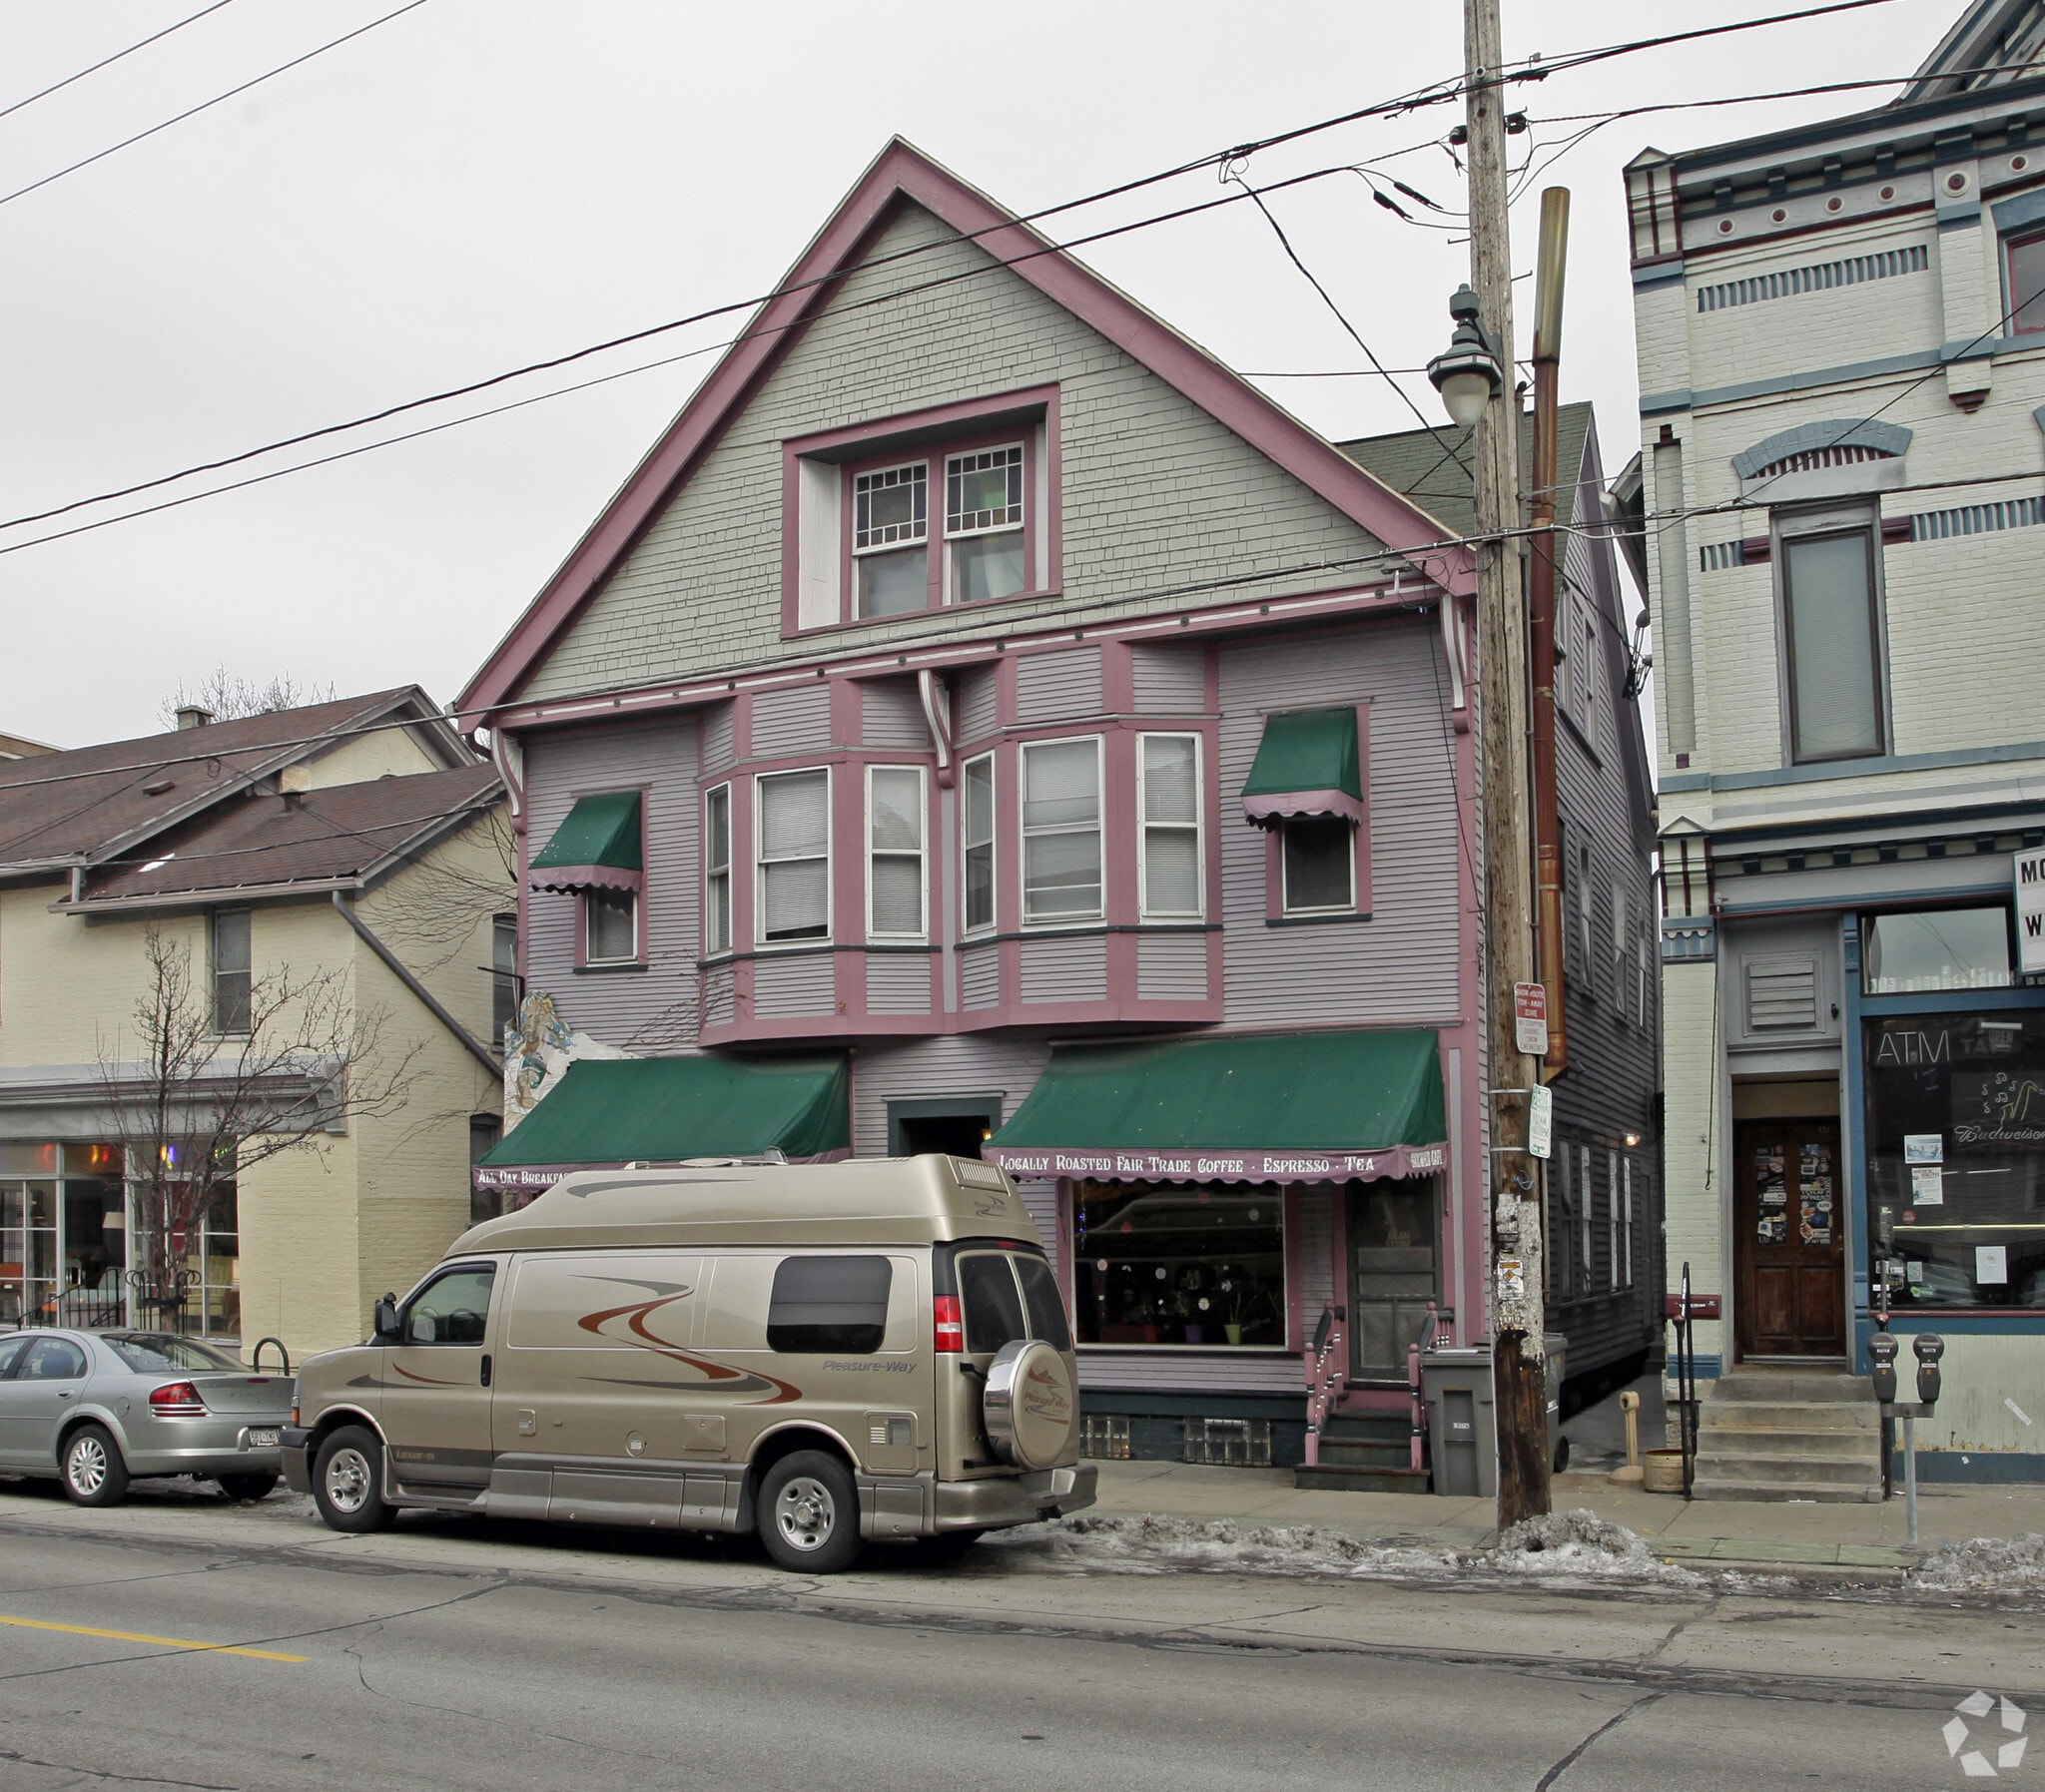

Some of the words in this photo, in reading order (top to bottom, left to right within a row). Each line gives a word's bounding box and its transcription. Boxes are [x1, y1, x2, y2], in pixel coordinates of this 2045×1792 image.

[1988, 1030, 2013, 1044] OPEN
[1876, 1029, 1950, 1065] ATM
[999, 1154, 1049, 1171] LOCALLY
[1055, 1155, 1111, 1172] ROASTED
[1116, 1155, 1144, 1172] FAIR
[1148, 1156, 1191, 1173] TRADE
[1197, 1157, 1244, 1174] COFFEE
[1263, 1157, 1330, 1174] ESPRESSO
[1343, 1155, 1375, 1172] TEA
[478, 1170, 497, 1184] ALL
[499, 1170, 518, 1184] DAY
[822, 1359, 918, 1375] Pleasure-Way
